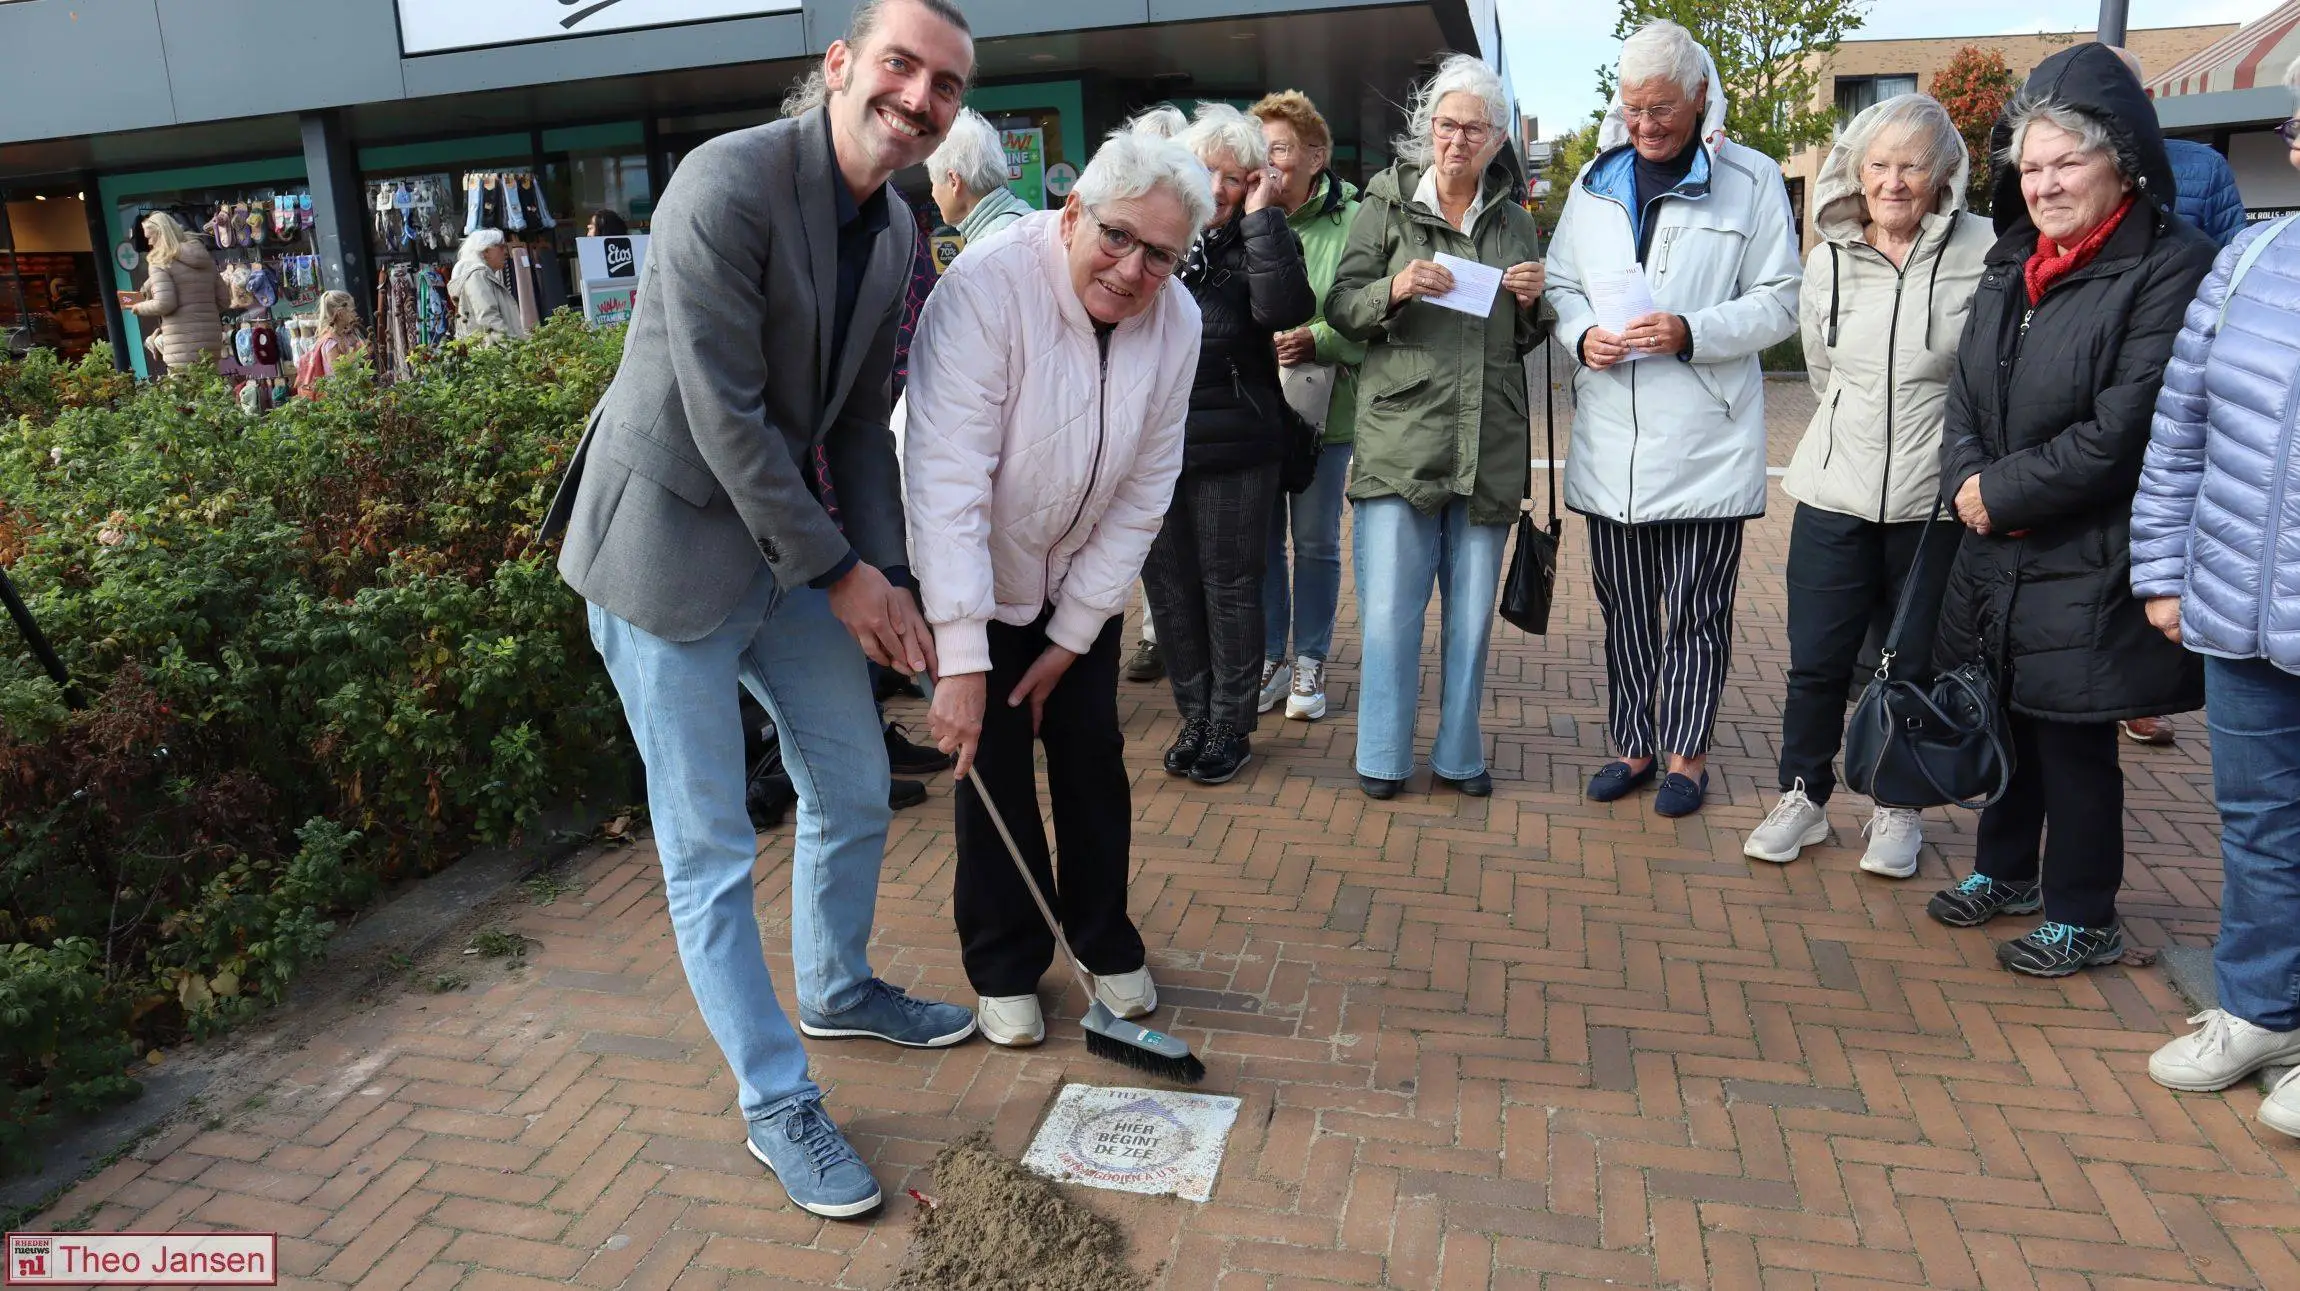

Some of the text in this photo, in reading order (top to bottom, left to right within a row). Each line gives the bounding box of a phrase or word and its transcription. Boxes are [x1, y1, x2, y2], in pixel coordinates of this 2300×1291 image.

[2257, 211, 2279, 219] ROLLS
[607, 243, 632, 265] Etos
[940, 248, 957, 256] 70%
[1114, 1121, 1155, 1135] HIER
[1098, 1133, 1162, 1148] BEGINT
[1094, 1143, 1155, 1160] DE ZEE
